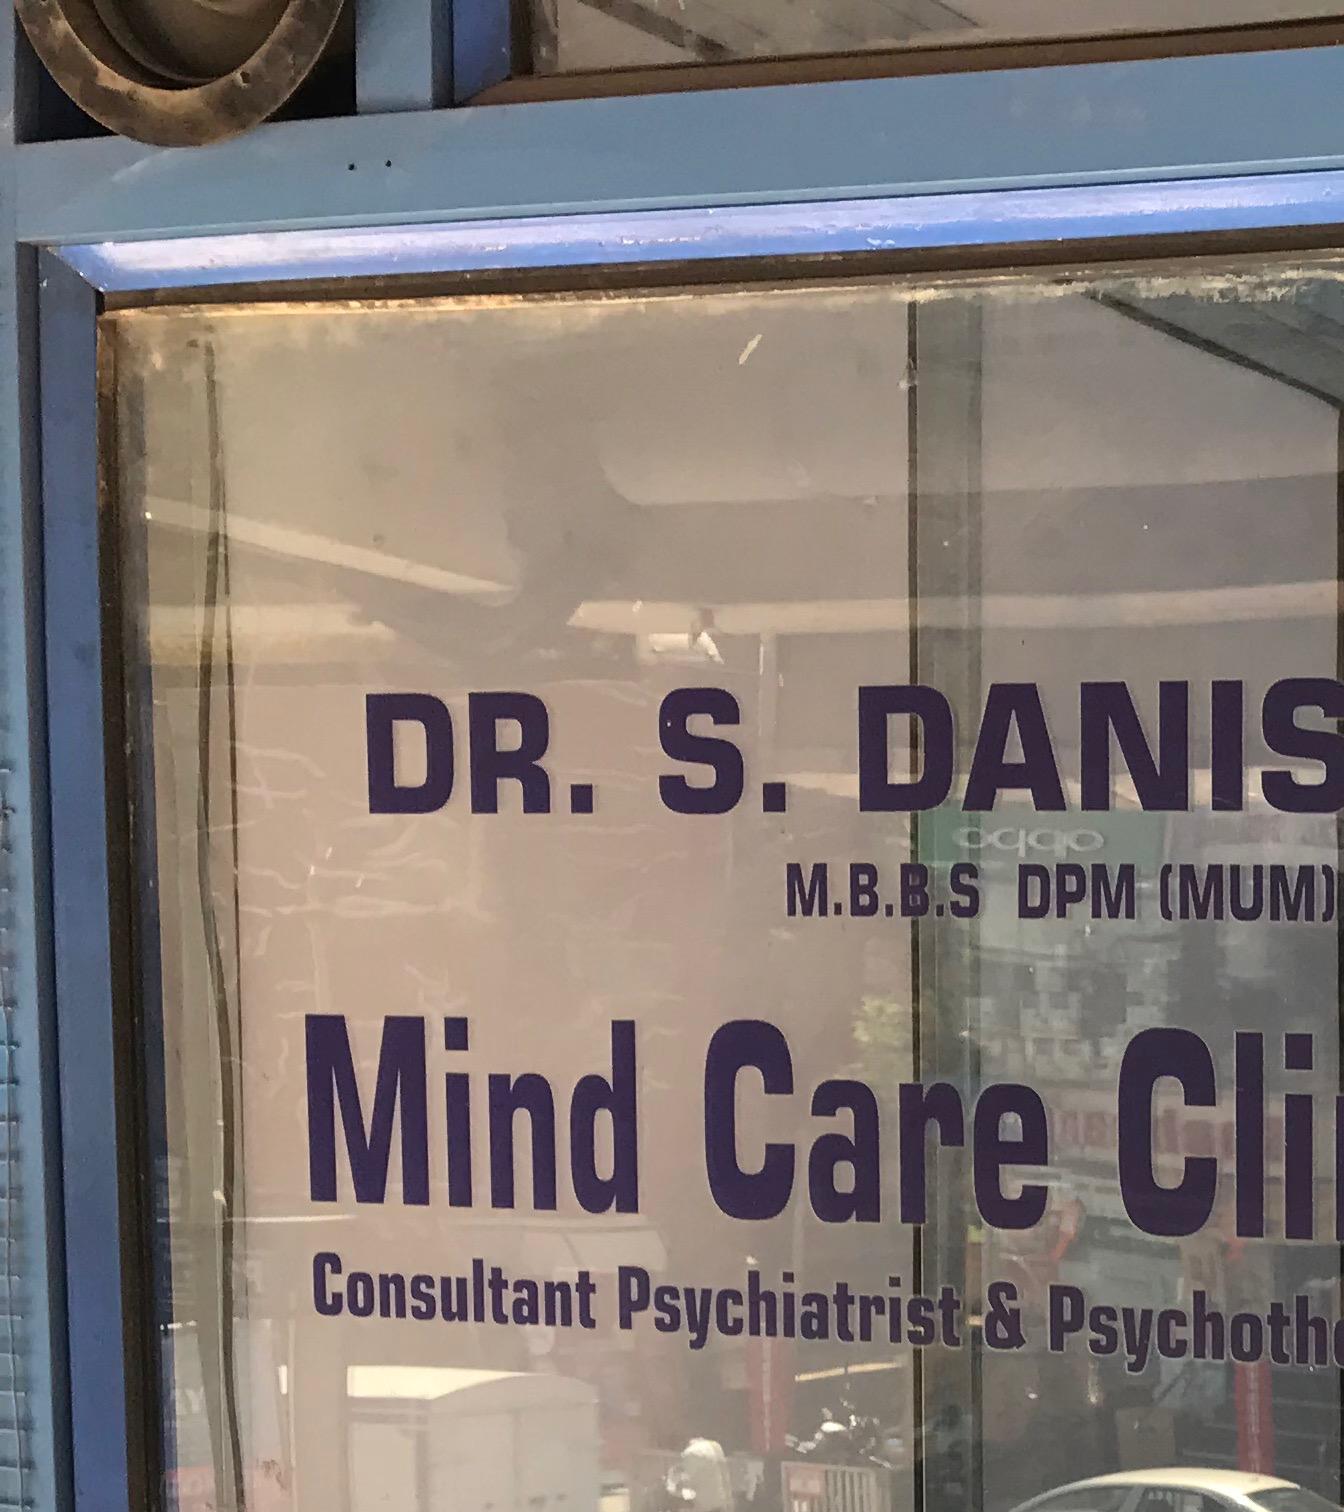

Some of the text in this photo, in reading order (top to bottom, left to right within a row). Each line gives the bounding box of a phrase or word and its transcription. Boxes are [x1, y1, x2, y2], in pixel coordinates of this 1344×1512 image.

[365, 690, 595, 816] DR.
[656, 685, 789, 814] S.
[785, 862, 981, 919] M.B.B.S
[1017, 863, 1136, 921] DPM
[1160, 862, 1338, 923] (MUM)
[304, 1012, 640, 1216] Mind
[704, 1018, 1051, 1227] Care
[311, 1251, 598, 1331] Consultant
[617, 1263, 962, 1350] Psychiatrist
[982, 1282, 1027, 1350] &
